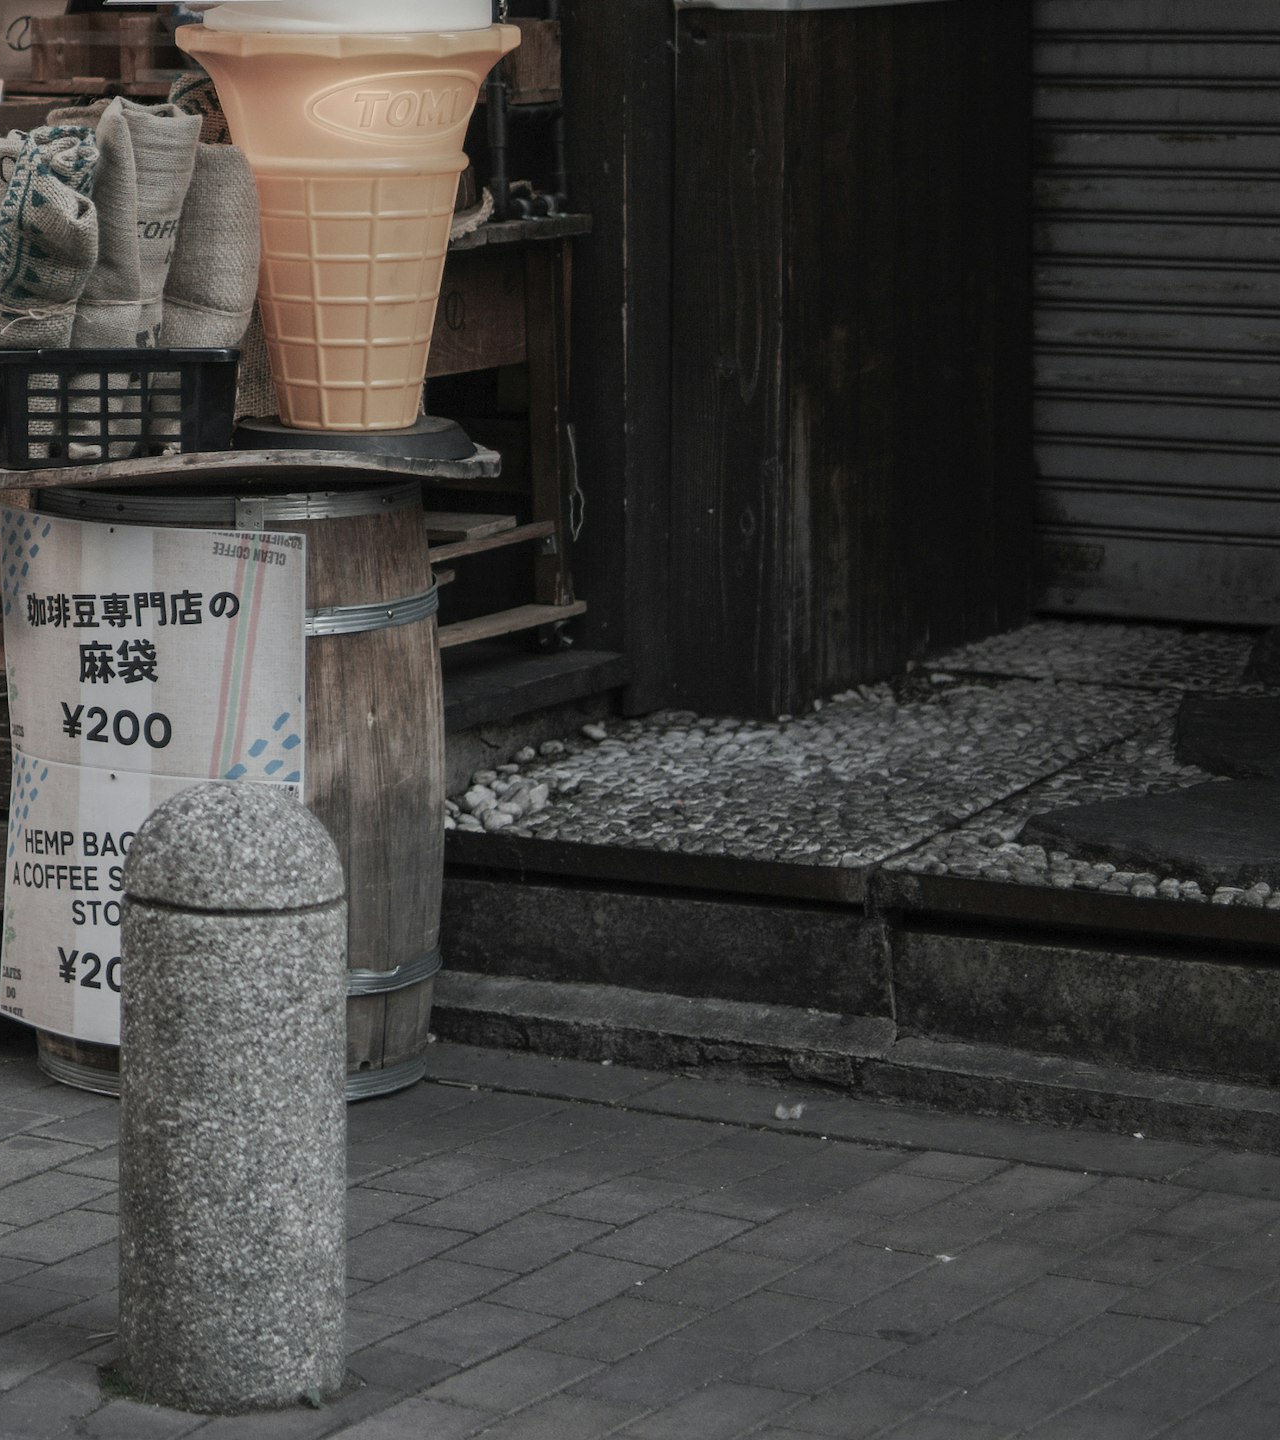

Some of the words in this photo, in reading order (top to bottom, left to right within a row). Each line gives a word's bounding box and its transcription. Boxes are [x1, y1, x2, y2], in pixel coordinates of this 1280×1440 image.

[211, 541, 250, 562] COFFEE
[251, 545, 287, 566] CLEAN
[26, 589, 241, 629] 珈琲豆専門店の
[79, 638, 160, 685] 麻袋
[60, 701, 173, 750] ¥200
[24, 828, 75, 856] HEMP
[13, 860, 21, 886] A
[23, 862, 100, 892] COFFEE
[6, 985, 16, 1000] DO
